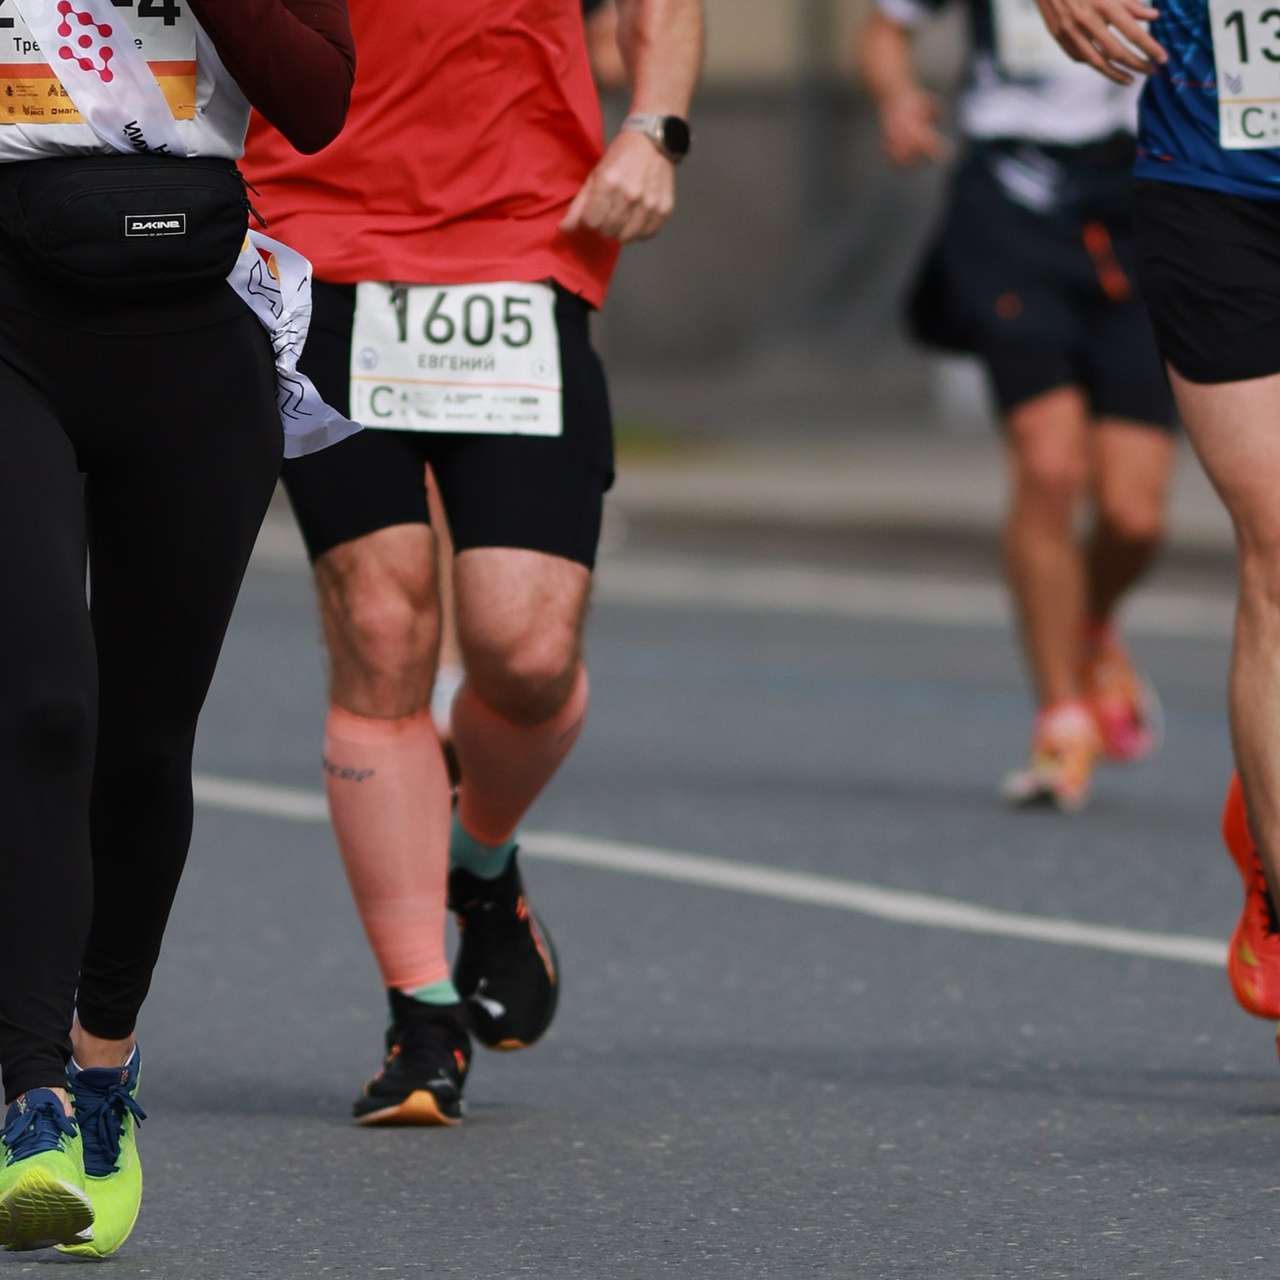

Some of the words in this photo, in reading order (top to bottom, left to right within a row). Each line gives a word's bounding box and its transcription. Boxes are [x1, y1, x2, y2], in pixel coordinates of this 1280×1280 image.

[131, 220, 181, 230] DAKINE
[389, 291, 532, 348] 1605
[417, 352, 496, 371] ЕВГЕНИЙ
